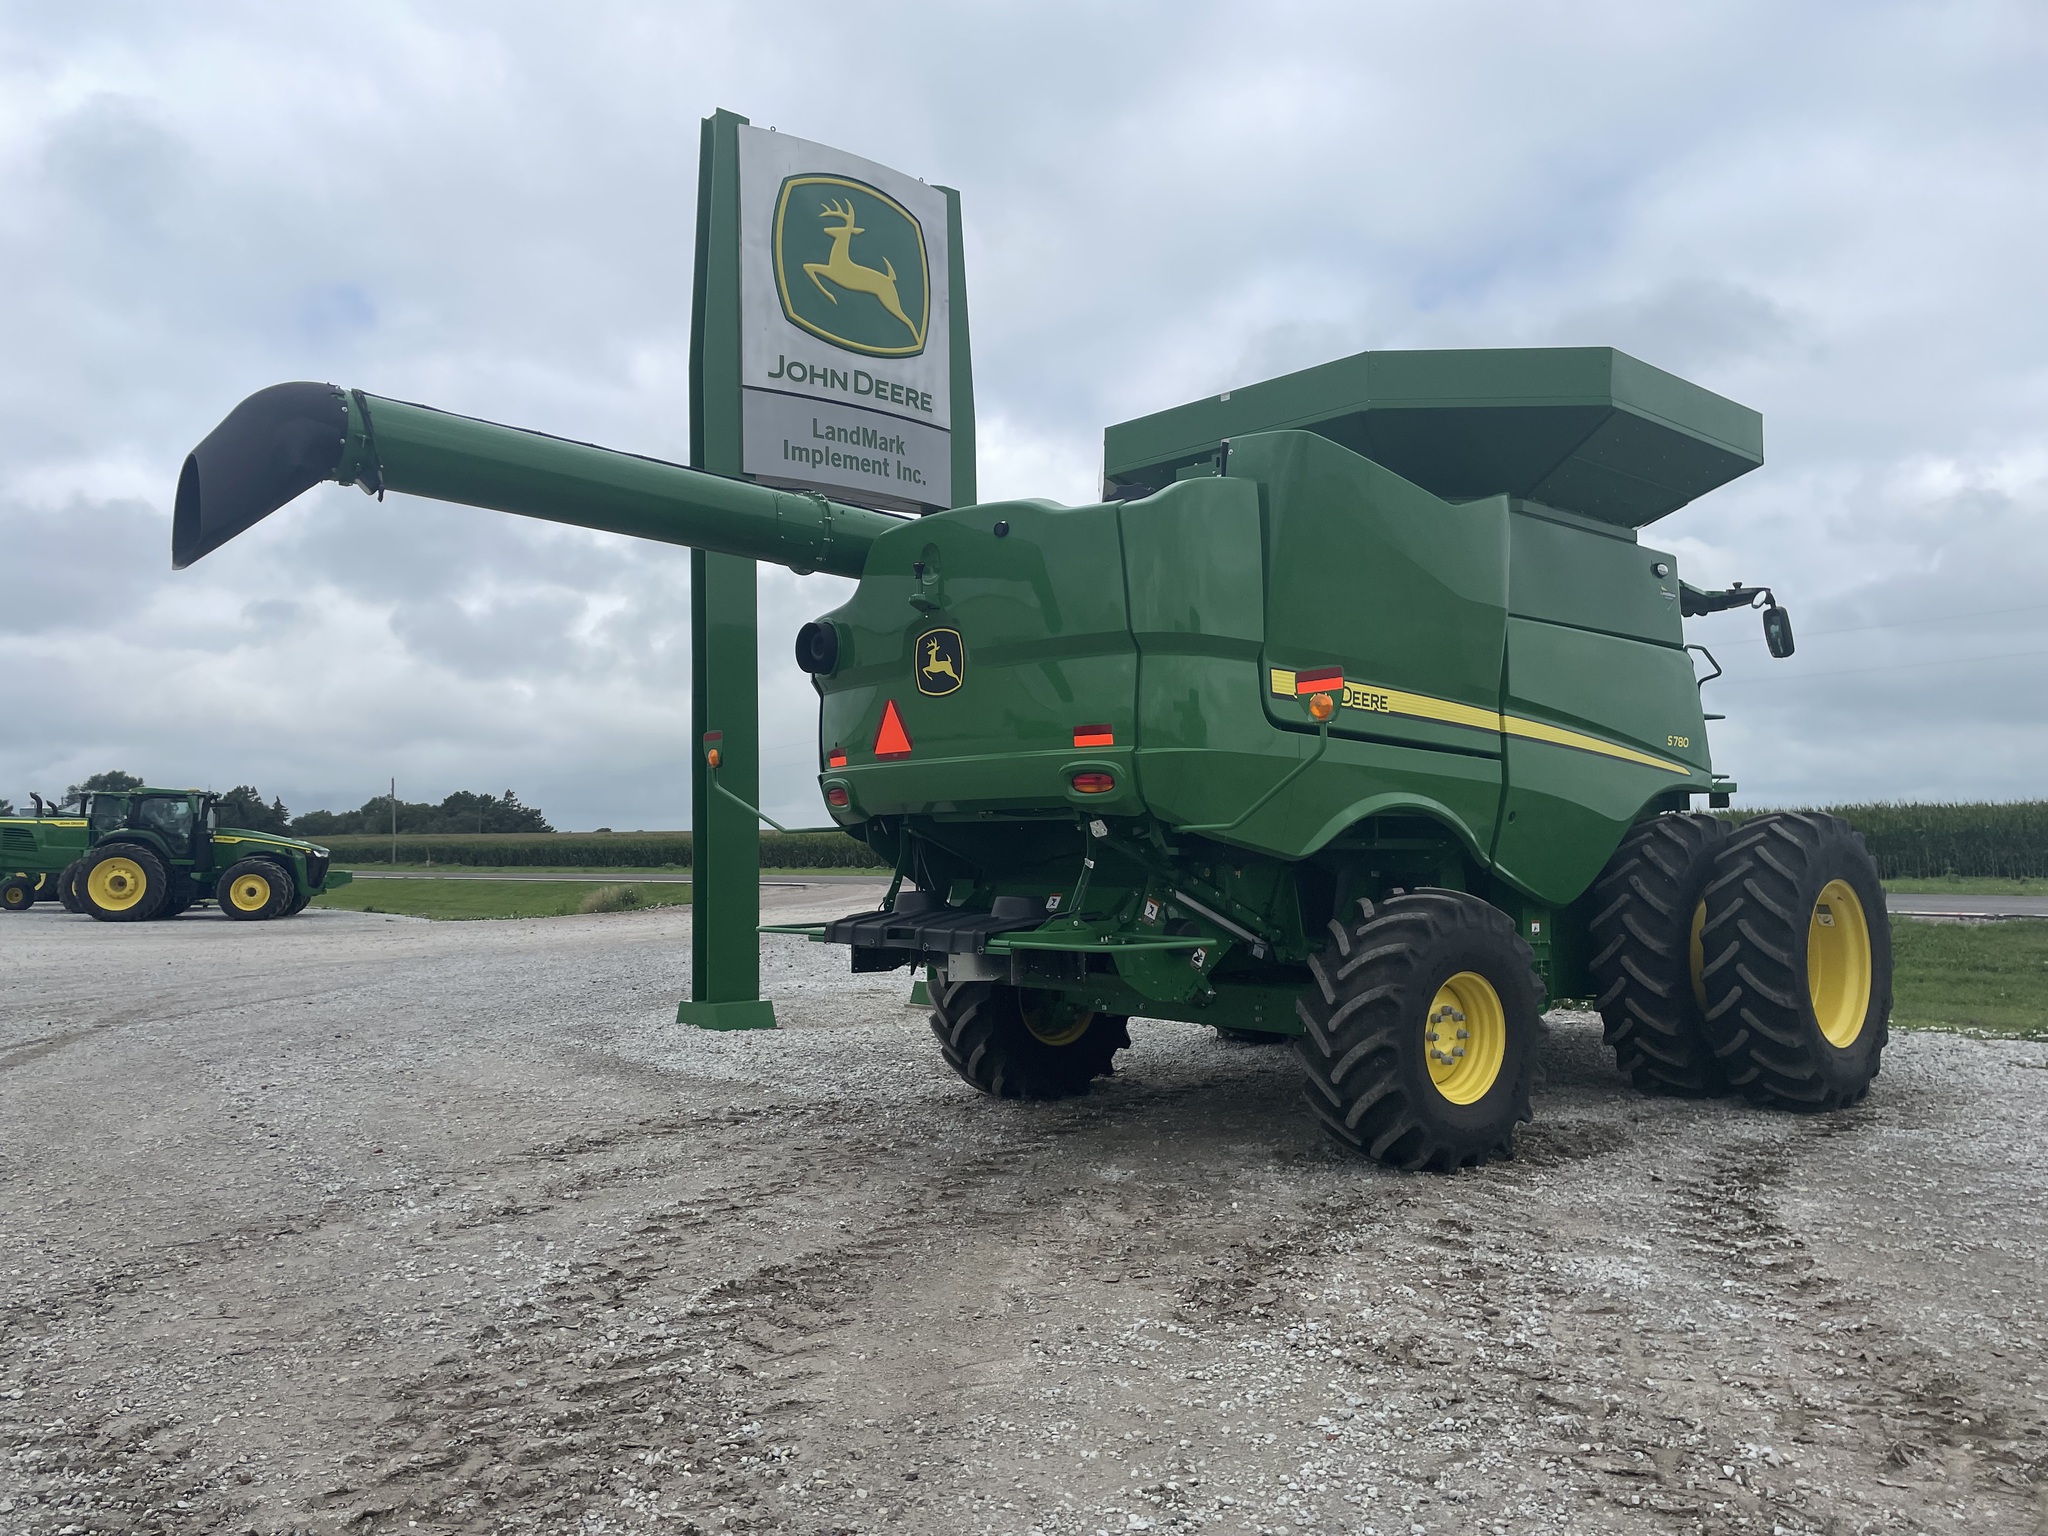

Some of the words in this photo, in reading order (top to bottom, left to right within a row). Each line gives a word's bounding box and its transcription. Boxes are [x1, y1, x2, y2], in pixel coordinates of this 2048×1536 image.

[768, 355, 848, 391] JOHN
[854, 369, 933, 413] DEERE
[812, 417, 906, 455] LandMark
[783, 439, 890, 478] Implement
[896, 460, 927, 486] Inc.
[1343, 686, 1388, 710] DEERE
